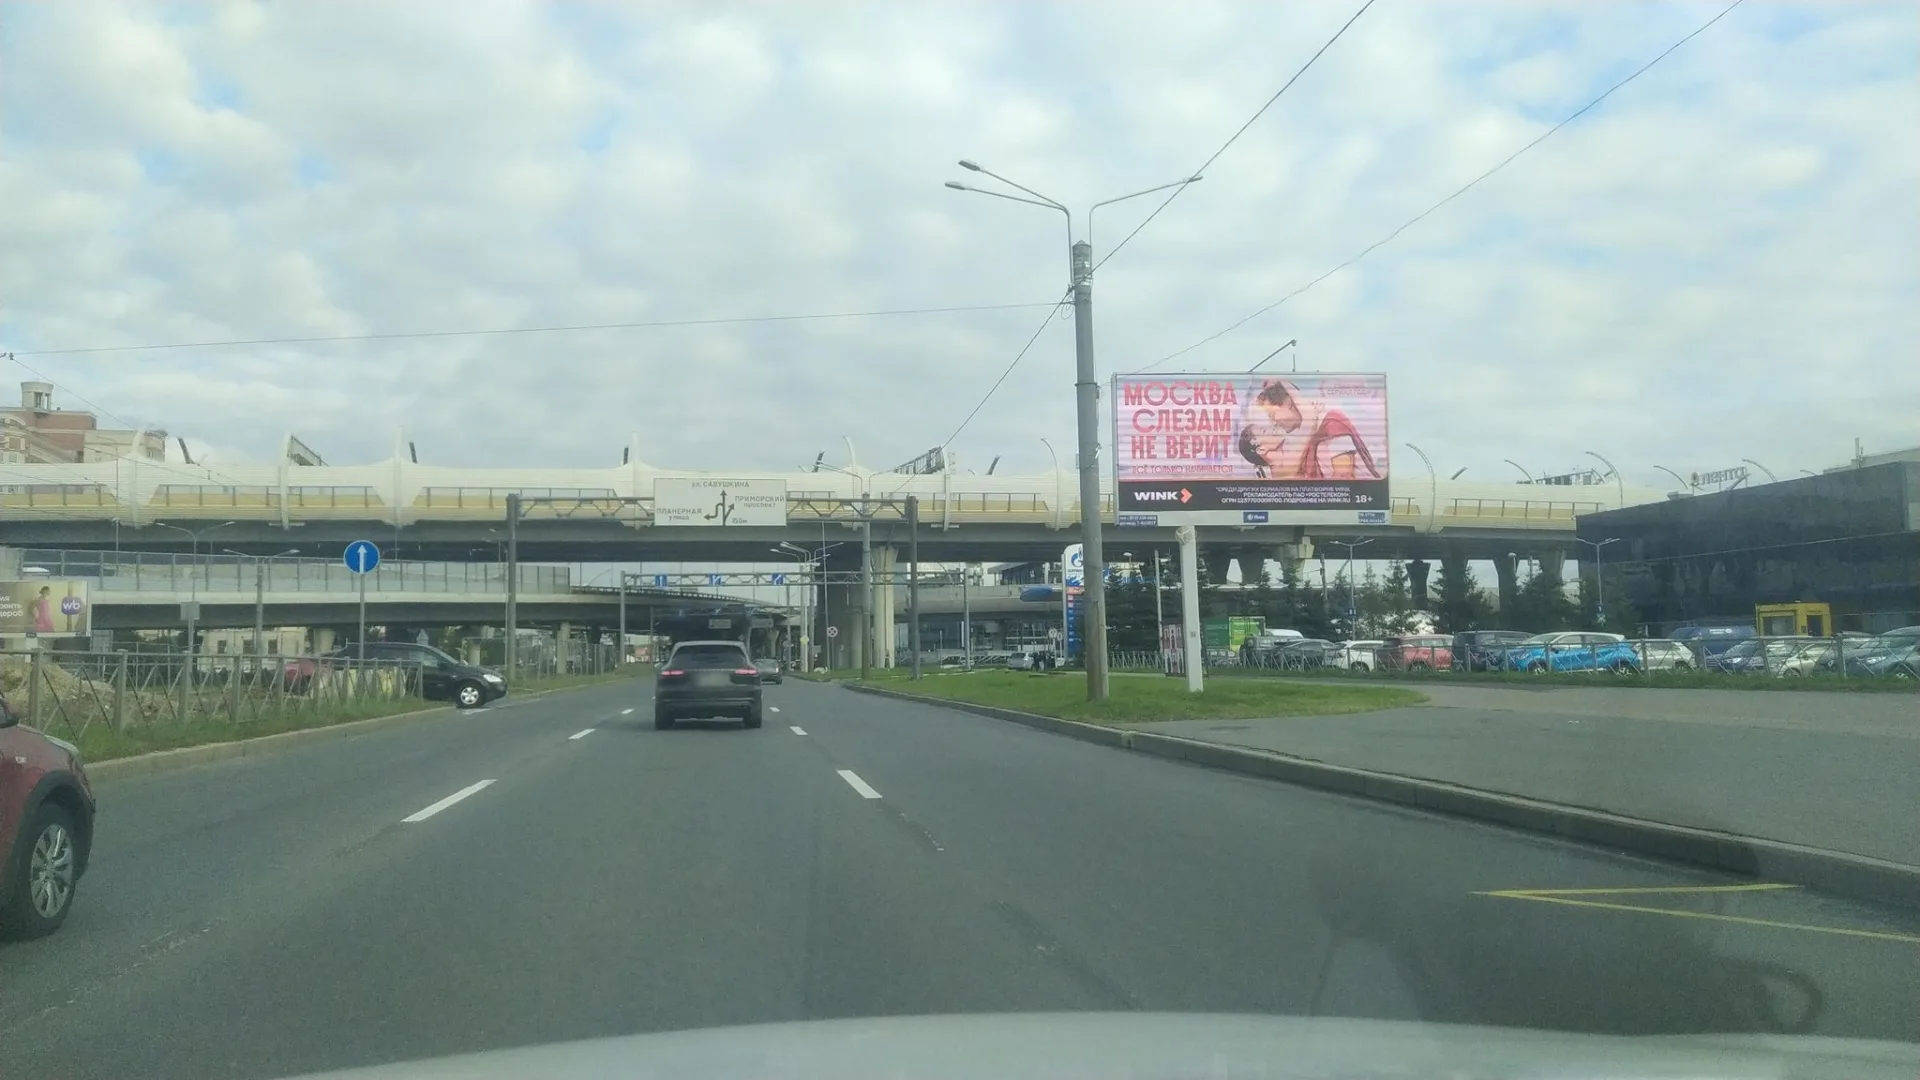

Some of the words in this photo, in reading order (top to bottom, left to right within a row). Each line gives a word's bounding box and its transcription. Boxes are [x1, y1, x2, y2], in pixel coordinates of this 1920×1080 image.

[1124, 381, 1237, 406] МОСКВА
[1132, 408, 1231, 433] СЛЕЗАМ
[1131, 435, 1157, 459] НЕ
[1166, 435, 1232, 459] ВЕРИТ
[1132, 464, 1148, 474] ВСЁ
[1151, 465, 1183, 474] ТОЛЬКО
[1185, 465, 1233, 474] НАЧИНАЕТСЯ
[1134, 491, 1178, 501] WINK
[1355, 495, 1373, 503] 18+
[62, 600, 81, 610] wb
